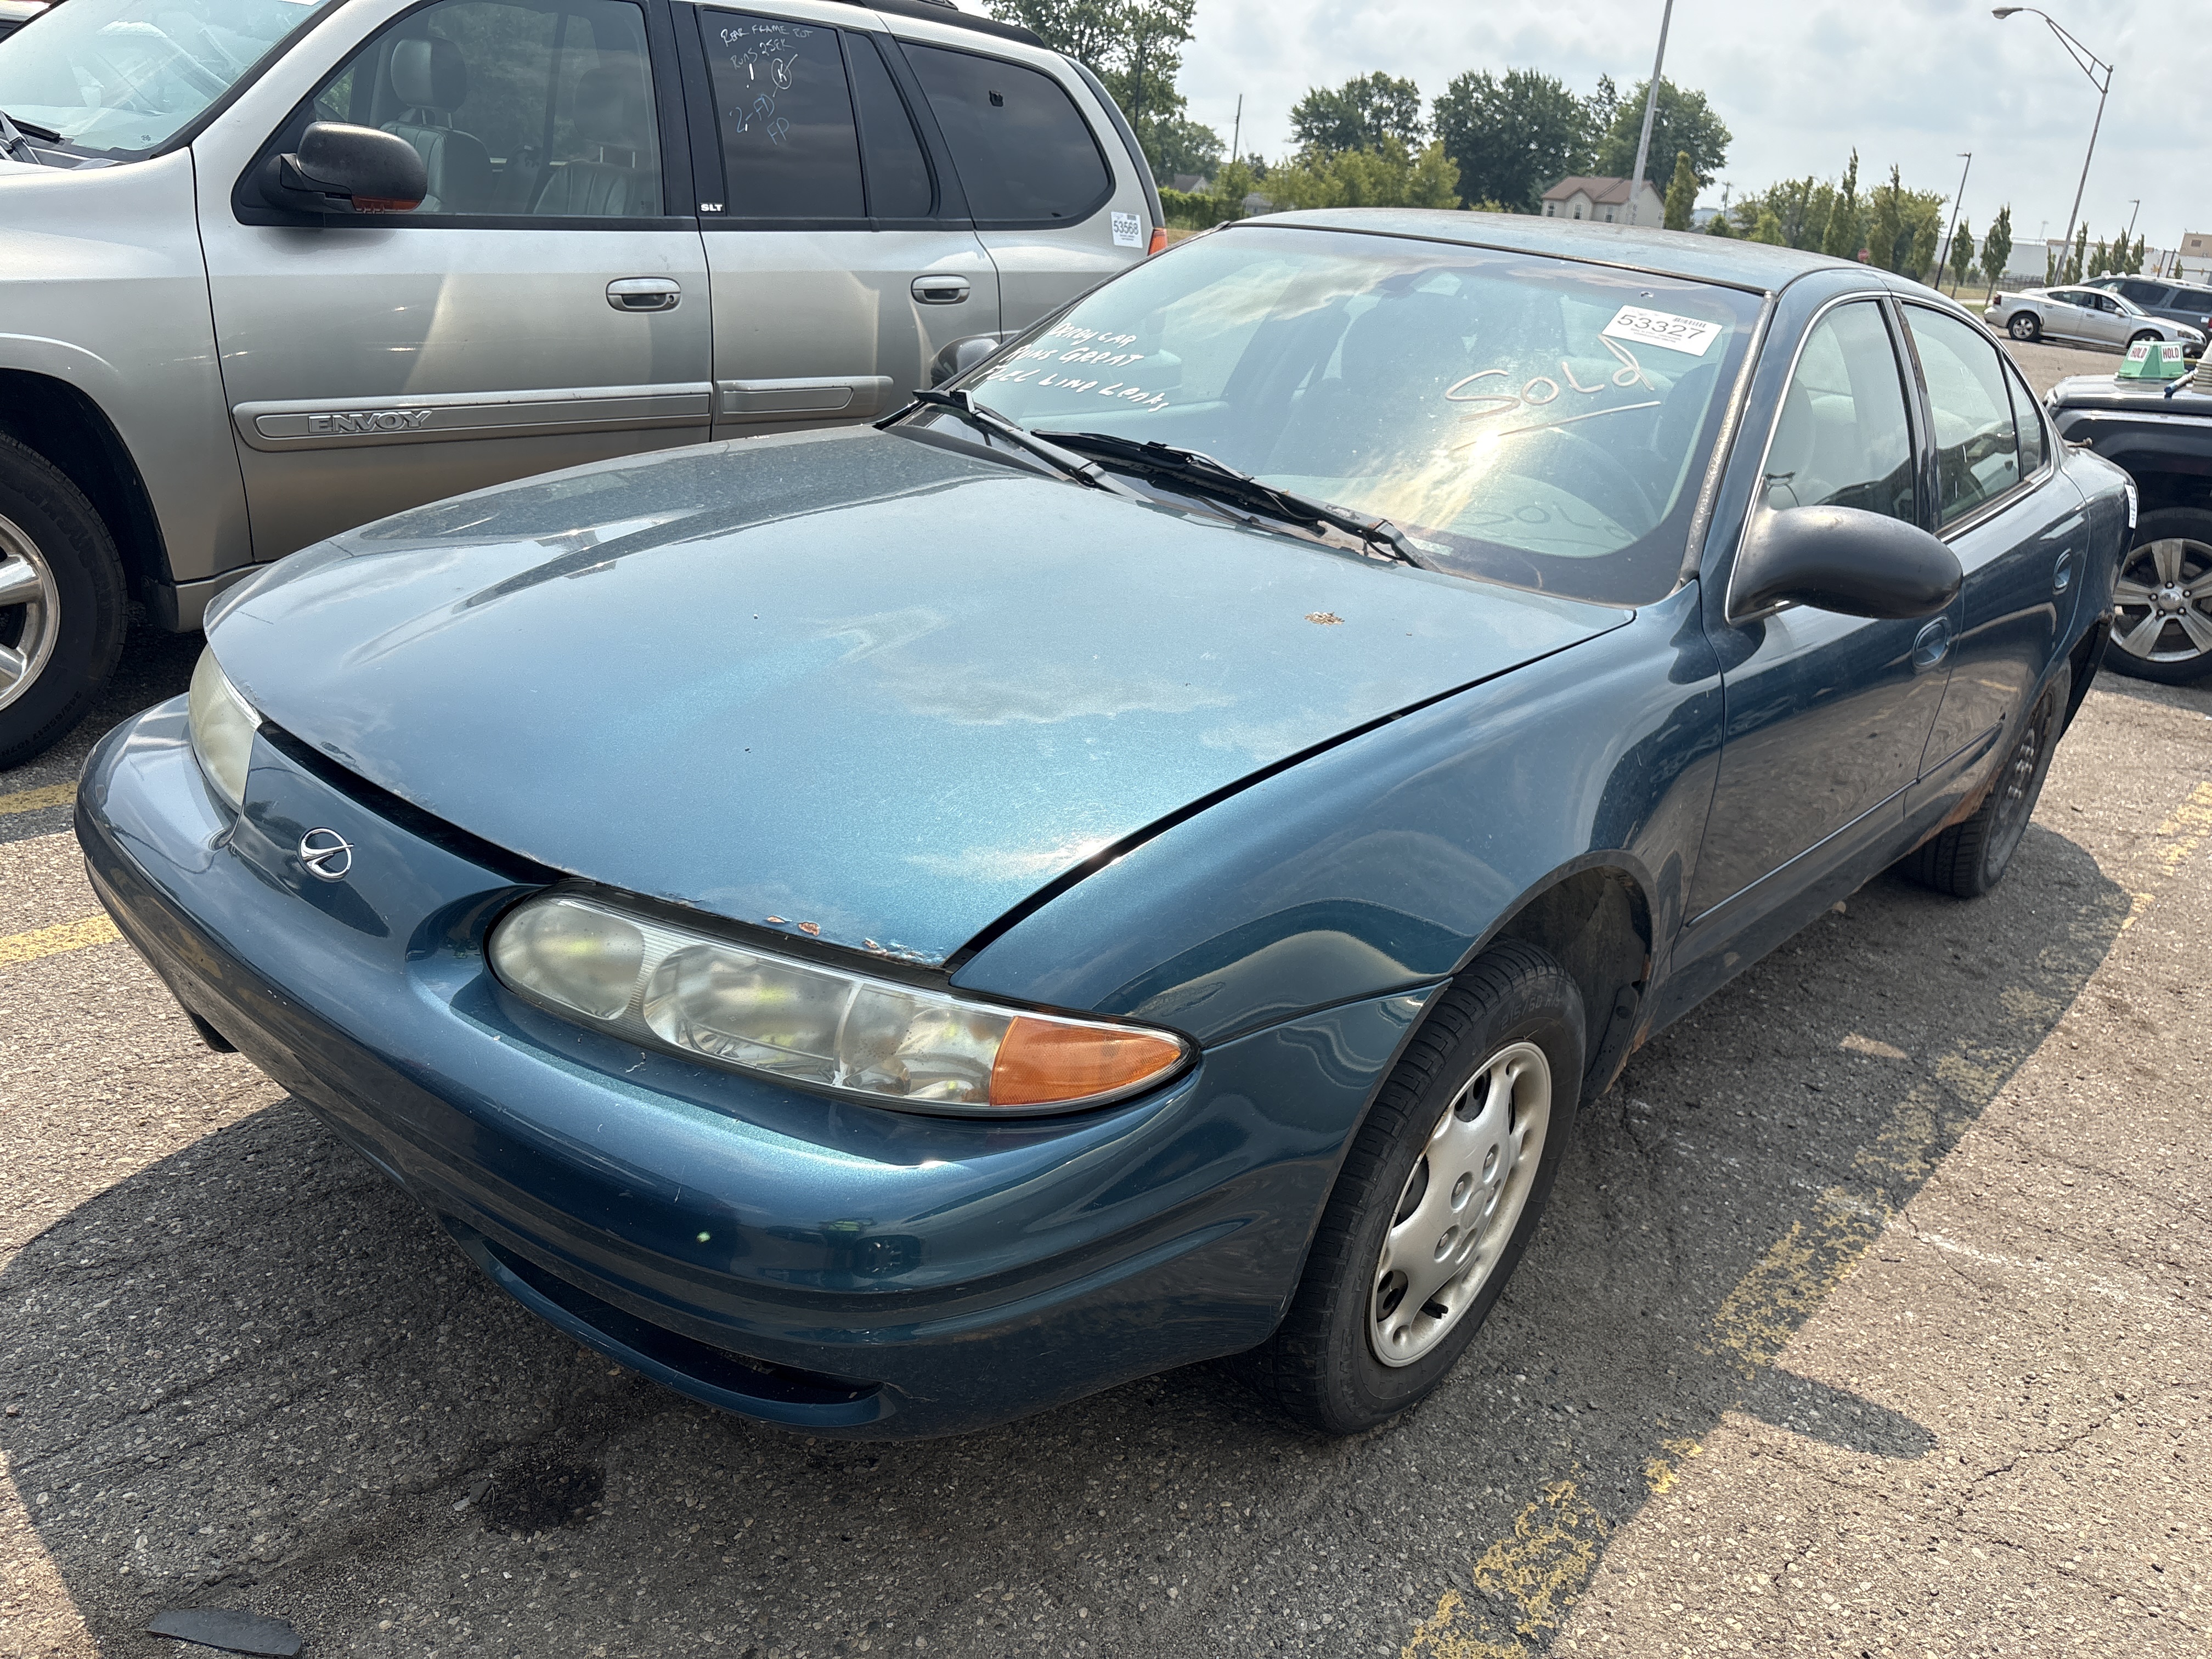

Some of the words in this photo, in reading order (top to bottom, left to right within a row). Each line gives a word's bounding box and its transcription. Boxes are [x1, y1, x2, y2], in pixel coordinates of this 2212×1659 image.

[1113, 220, 1139, 235] 53568
[1617, 314, 1706, 338] 53327
[2163, 347, 2179, 359] HOLD
[308, 410, 432, 433] ENVOY
